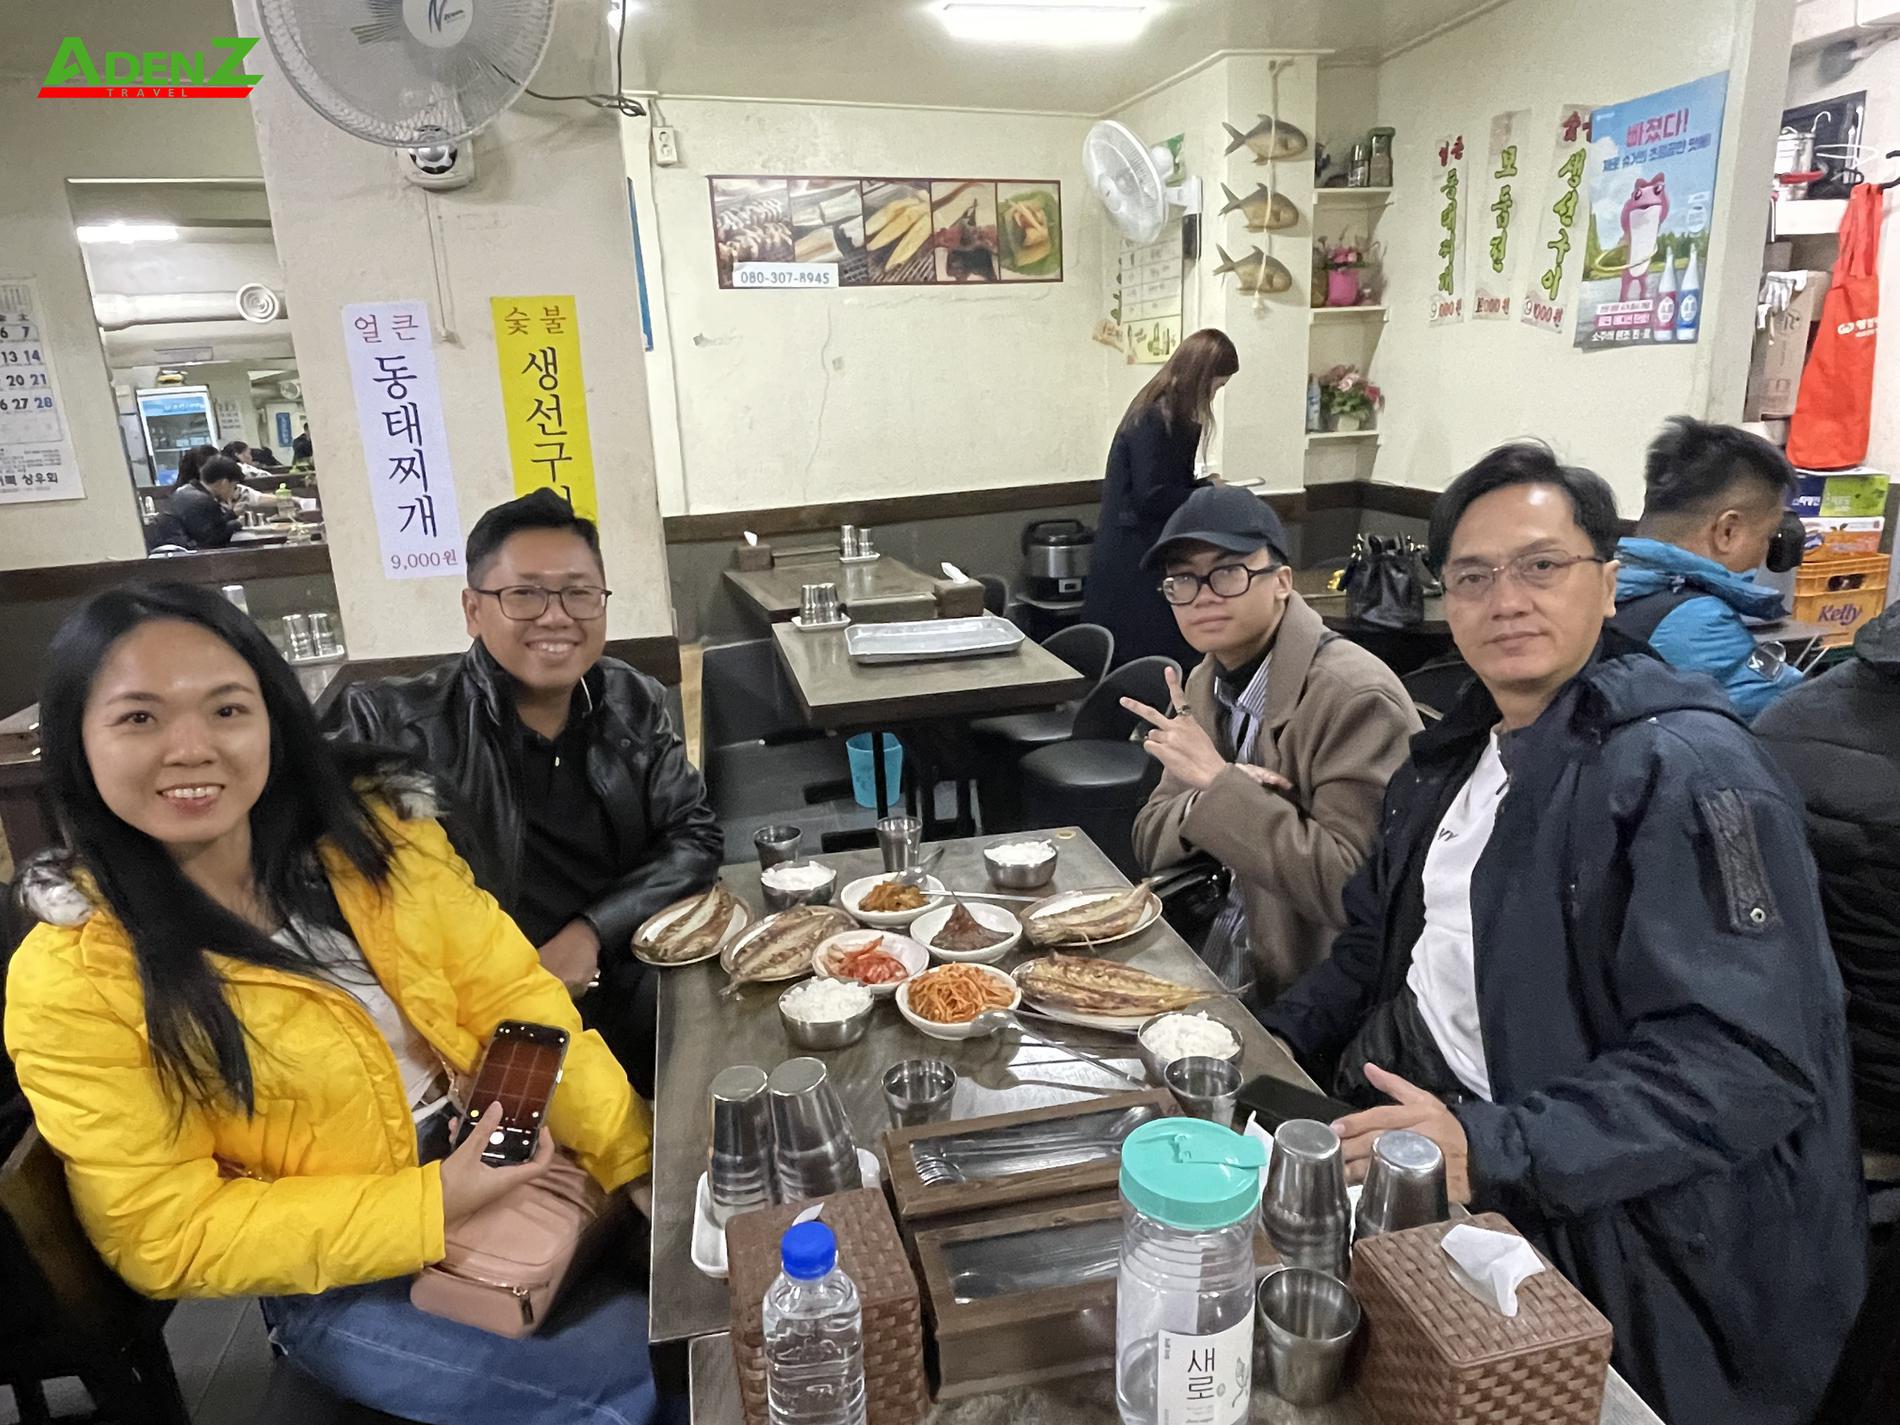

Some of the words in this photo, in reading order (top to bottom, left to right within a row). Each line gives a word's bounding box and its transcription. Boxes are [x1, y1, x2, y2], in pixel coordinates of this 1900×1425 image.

[22, 326, 30, 338] 7
[1, 351, 18, 364] 13
[24, 350, 40, 365] 14
[6, 375, 25, 387] 20
[30, 373, 47, 386] 21
[0, 399, 8, 411] 6
[11, 398, 29, 410] 27
[34, 397, 53, 408] 28
[372, 355, 438, 538] 동태찌개
[390, 549, 459, 571] 9,000원
[1818, 603, 1863, 626] Kelly
[1186, 1347, 1215, 1400] 새로
